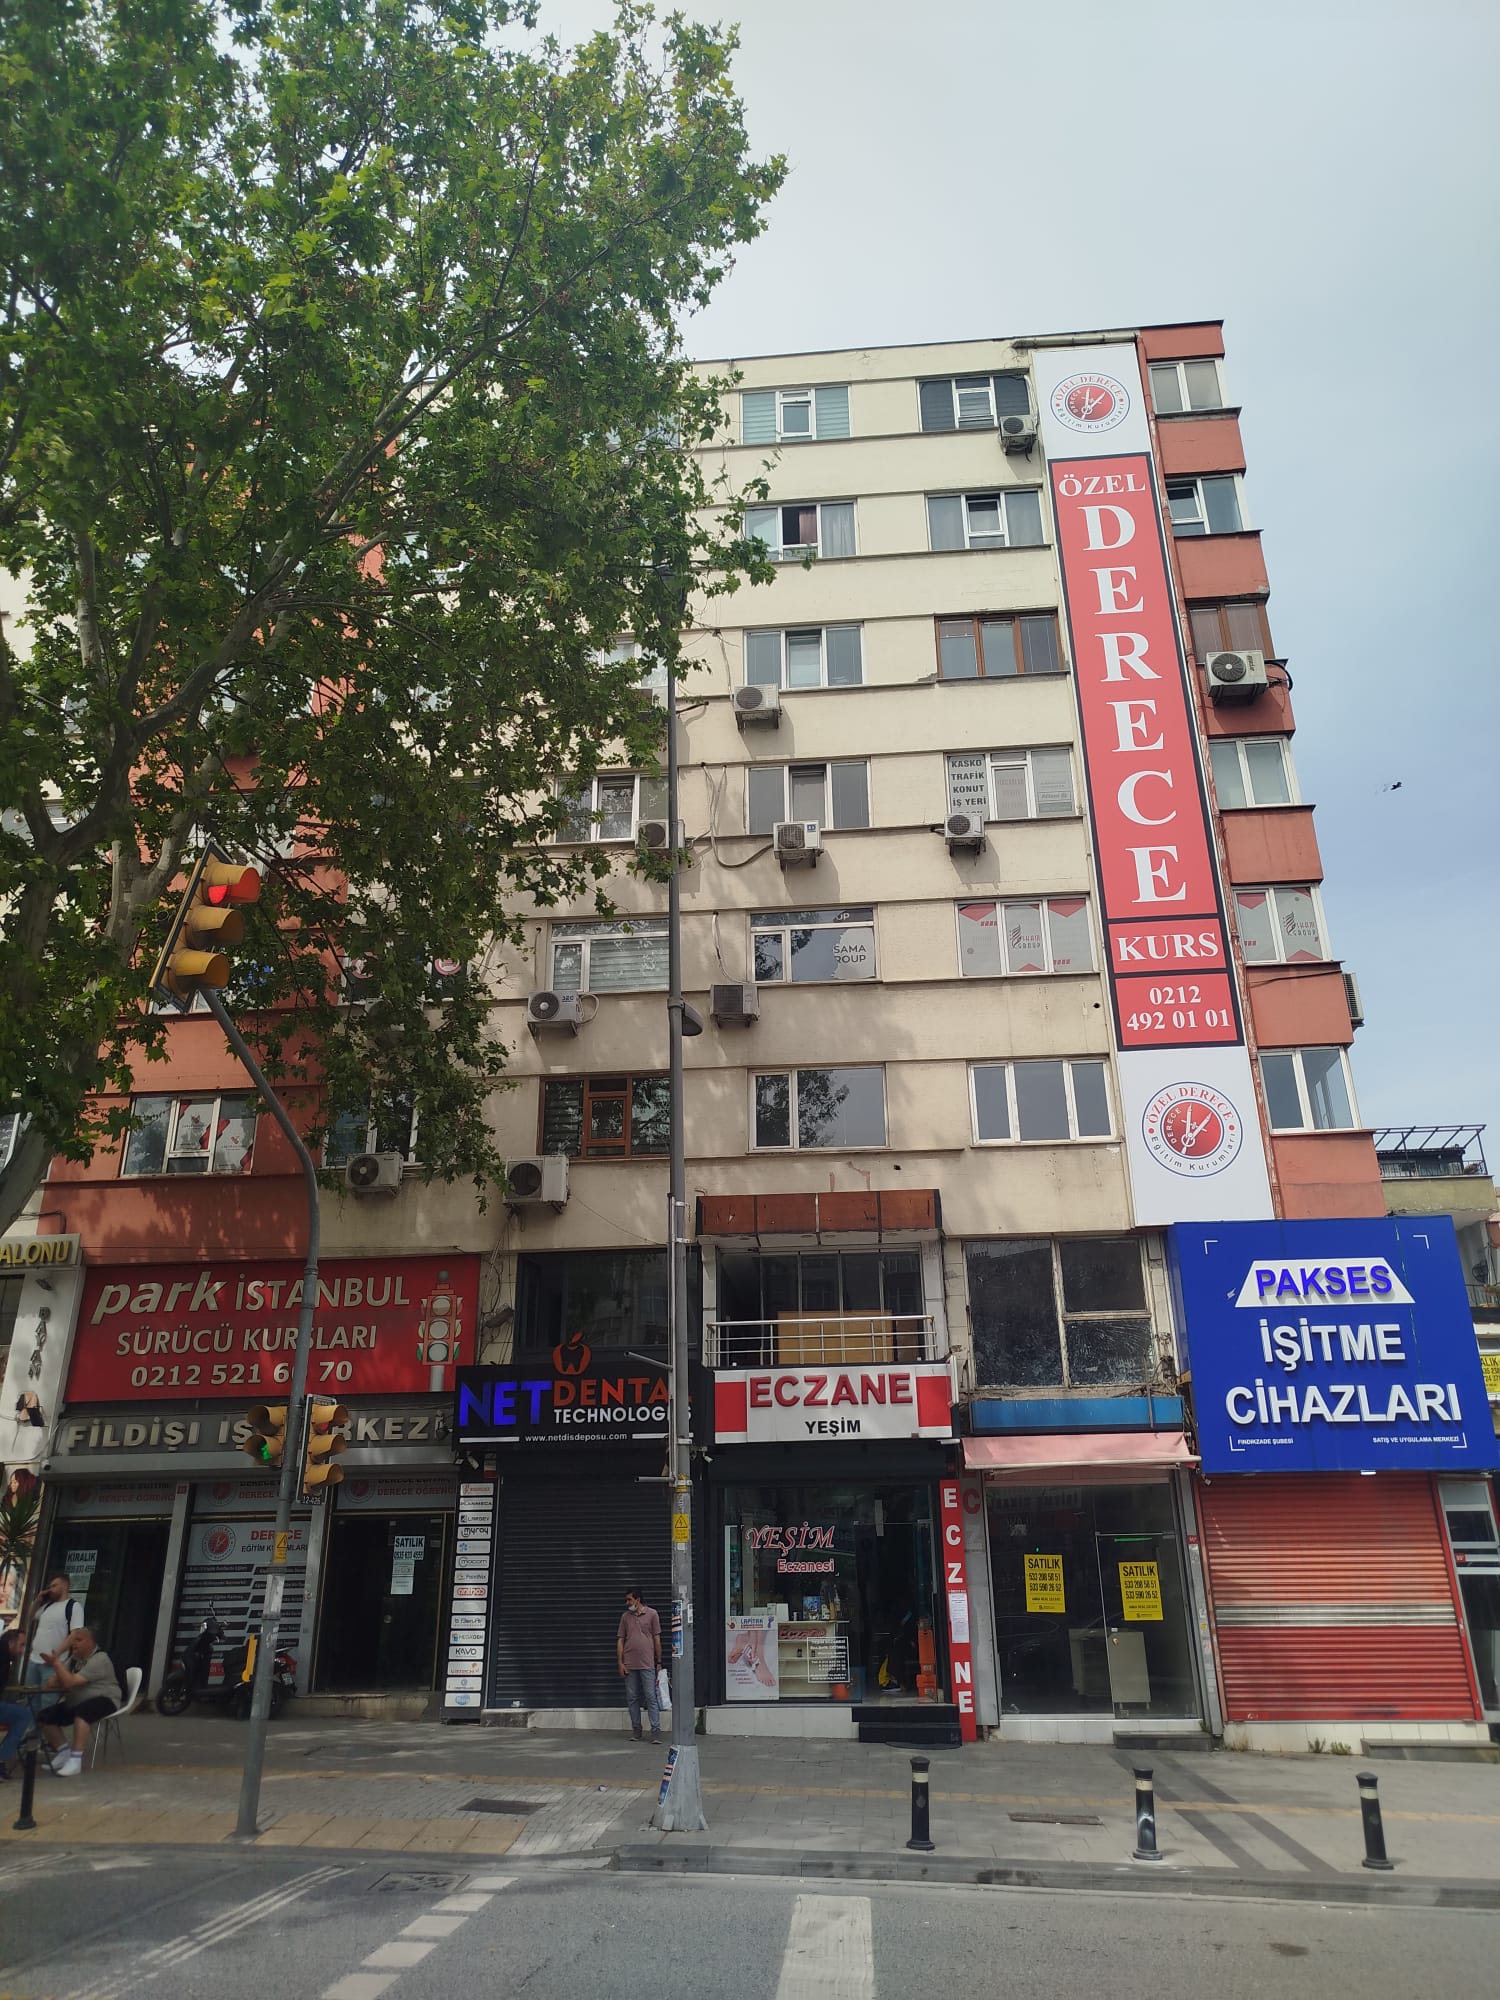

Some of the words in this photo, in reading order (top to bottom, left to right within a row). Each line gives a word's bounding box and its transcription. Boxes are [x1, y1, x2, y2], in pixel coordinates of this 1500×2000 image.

[1059, 474, 1146, 497] ÖZEL
[1077, 505, 1187, 904] DERECE
[952, 759, 982, 768] KASKO
[952, 771, 985, 781] TRAFİK
[953, 785, 985, 793] KONUT
[953, 797, 962, 807] İŞ
[965, 796, 987, 806] YERİ
[1116, 932, 1219, 961] KURS
[1149, 985, 1201, 1005] 0212
[1127, 1011, 1166, 1031] 492
[1172, 1010, 1198, 1029] 01
[1205, 1008, 1231, 1028] 01
[1146, 1092, 1176, 1124] ÖZEL
[1178, 1087, 1234, 1121] DERECE
[1166, 1107, 1182, 1145] DERECE
[1256, 1265, 1393, 1297] PAKSES
[90, 1271, 227, 1325] park
[235, 1273, 410, 1311] İSTANBUL
[116, 1322, 233, 1356] SÜRÜCÜ
[1259, 1317, 1406, 1371] İŞİTME
[131, 1365, 201, 1387] 0212
[211, 1363, 261, 1385] 521
[273, 1362, 294, 1384] 6
[319, 1360, 353, 1382] 70
[459, 1380, 552, 1427] NET
[554, 1377, 692, 1407] DENTA
[750, 1373, 913, 1408] ECZANE
[1226, 1378, 1462, 1424] CİHAZLARI
[525, 1432, 628, 1442] www.netdisdeposu.com
[805, 1417, 861, 1437] YEŞİM
[395, 1537, 424, 1548] SATILIK
[745, 1521, 836, 1557] YEŞİM
[777, 1558, 835, 1573] Eczanesi
[1028, 1559, 1061, 1569] SATILIK
[1123, 1566, 1156, 1576] SATILIK
[943, 1487, 974, 1713] ECZNE
